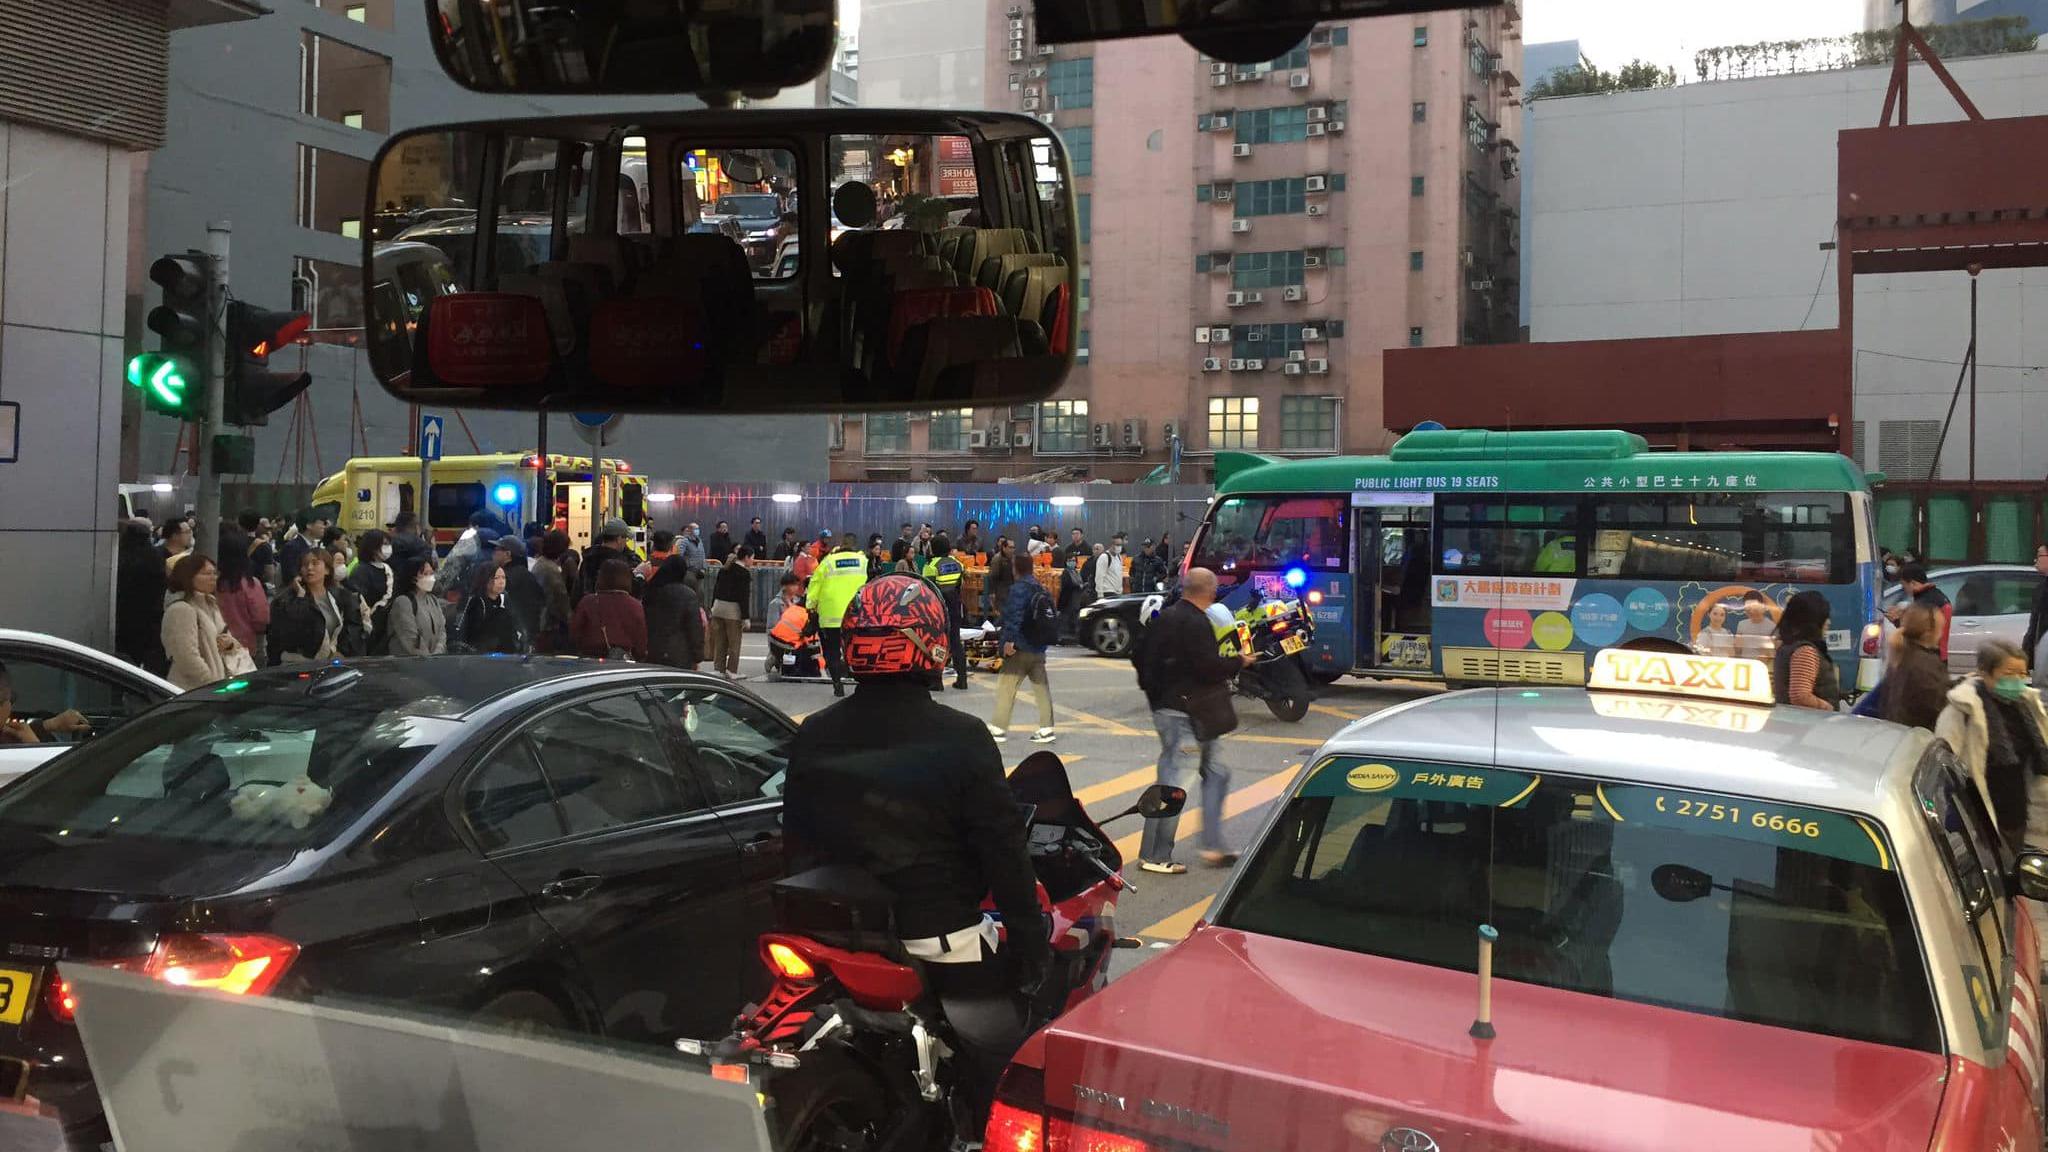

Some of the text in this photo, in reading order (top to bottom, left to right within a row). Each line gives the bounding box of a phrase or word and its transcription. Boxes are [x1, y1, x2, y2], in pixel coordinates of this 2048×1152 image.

[1354, 476, 1499, 488] PUBLIC LIGHT BUS 19 SEATS
[1583, 475, 1757, 488] 公共小型巴士十九座位
[1608, 653, 1751, 692] TAXI
[1676, 799, 1820, 838] 2751 6666
